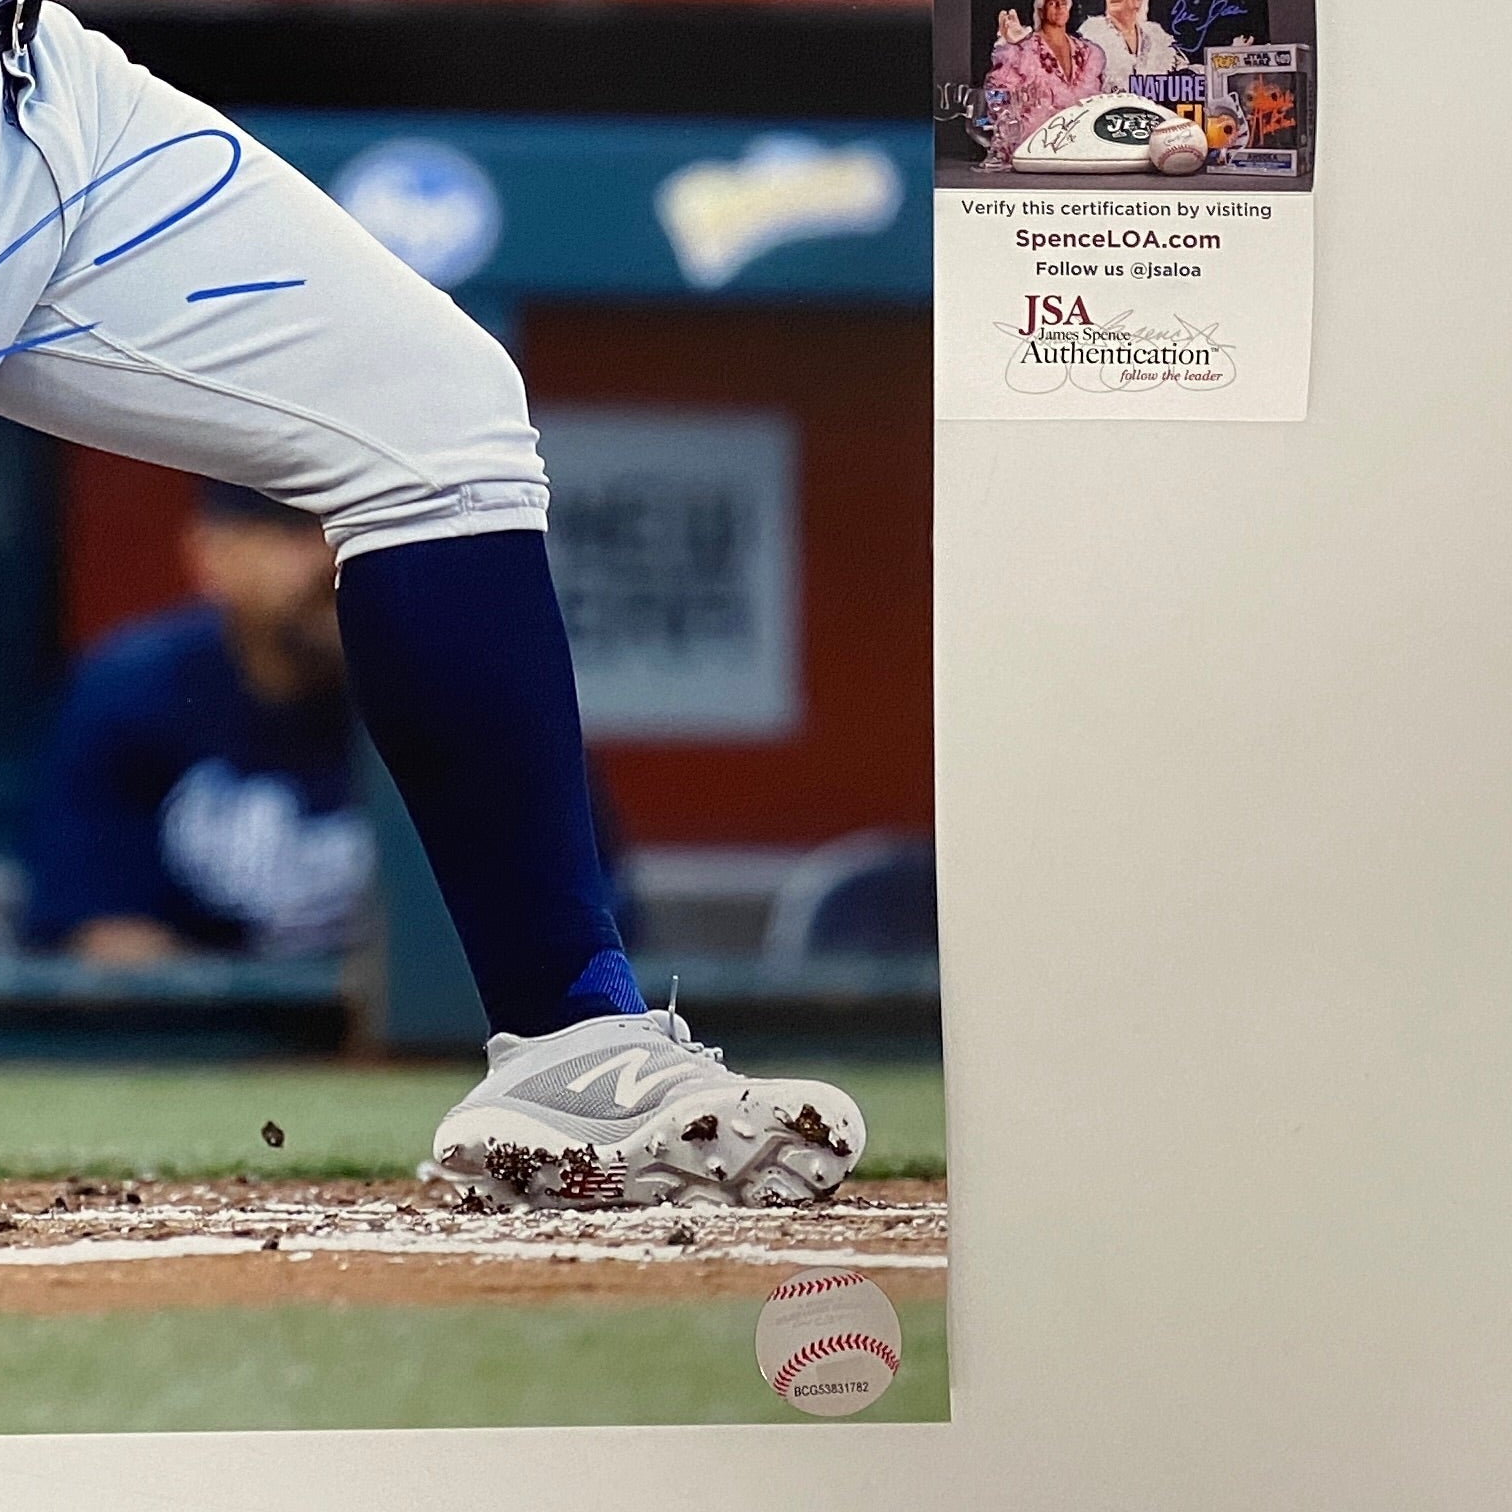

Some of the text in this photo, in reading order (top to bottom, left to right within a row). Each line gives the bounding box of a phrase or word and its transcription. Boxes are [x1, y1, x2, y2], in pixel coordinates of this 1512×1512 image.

[962, 200, 1272, 220] Verify this certification by visiting
[1016, 230, 1221, 251] SpenceLOA.com
[1036, 262, 1201, 279] Follow us @jsaloa
[1018, 295, 1094, 335] JSA
[1037, 328, 1131, 344] James Spence
[1120, 369, 1223, 383] follow the leader
[794, 1381, 869, 1397] BCG53831782
